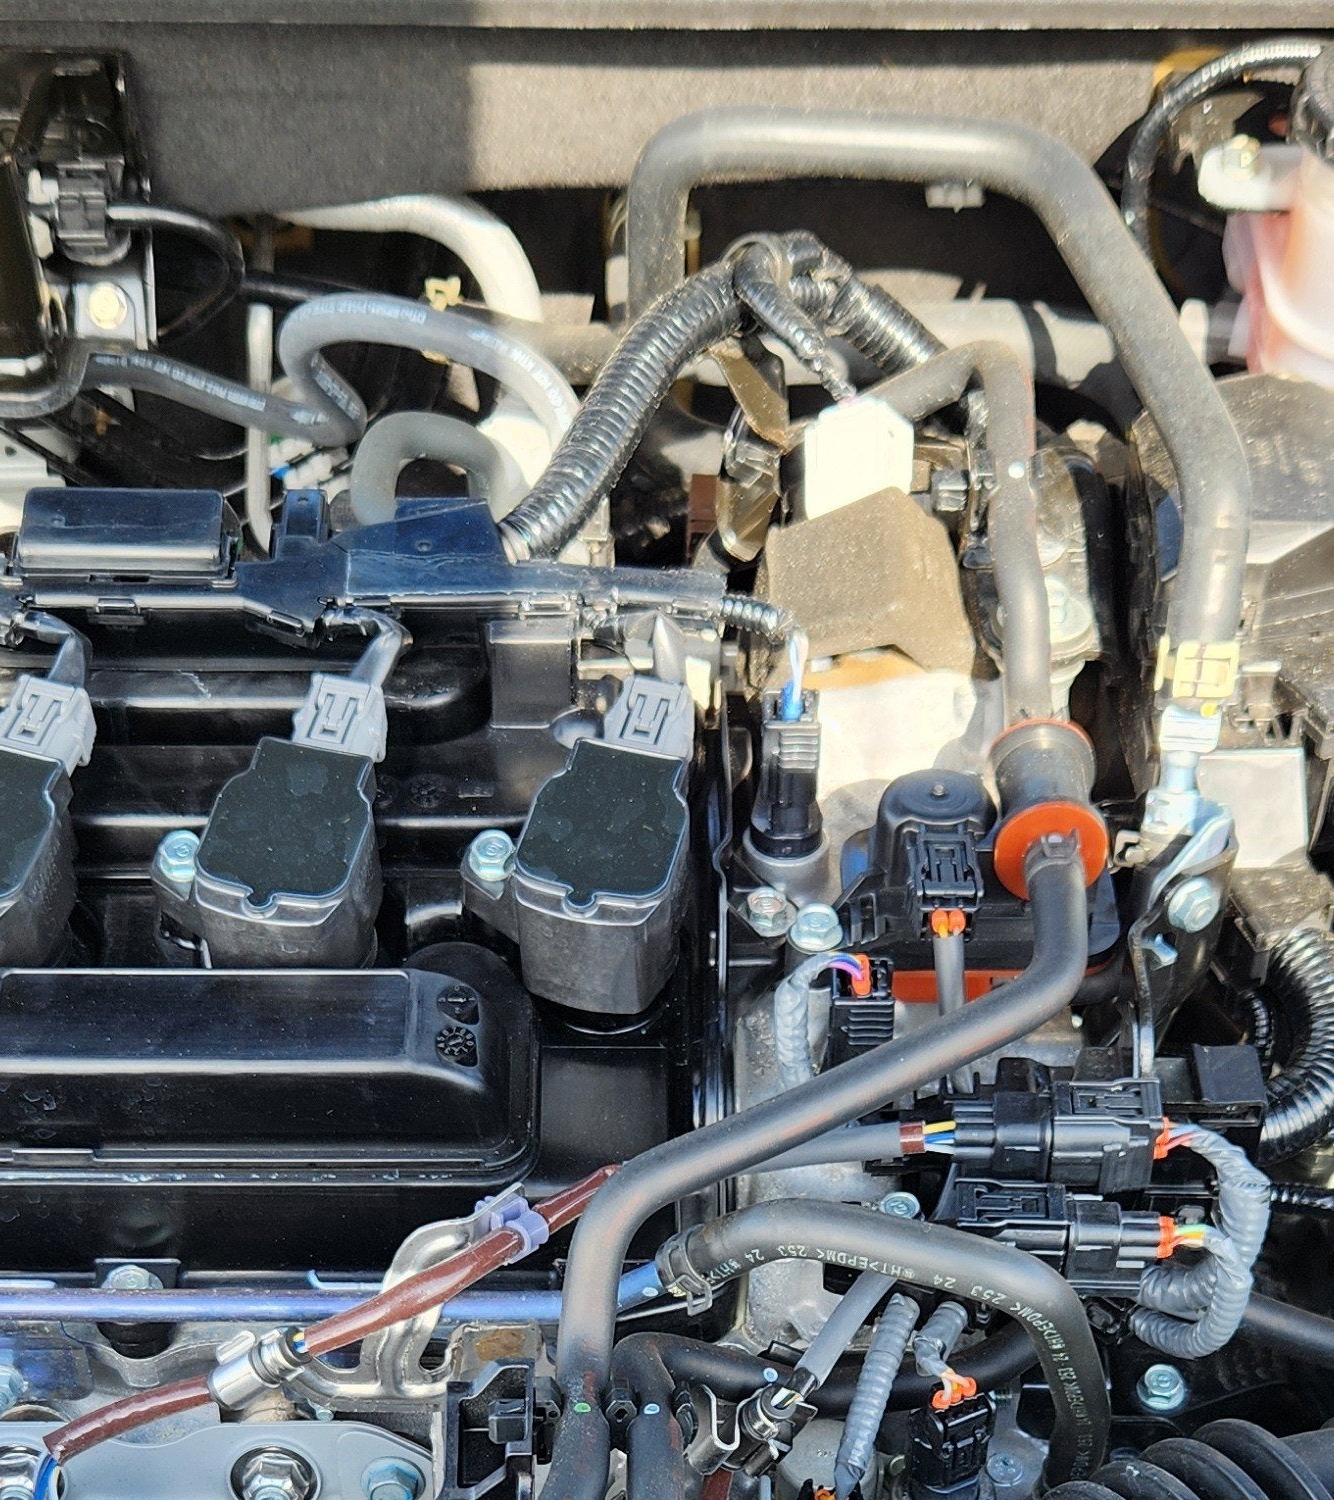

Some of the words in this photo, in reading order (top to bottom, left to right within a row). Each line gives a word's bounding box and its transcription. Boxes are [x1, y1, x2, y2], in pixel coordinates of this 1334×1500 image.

[745, 1248, 765, 1264] 24
[777, 1245, 808, 1258] 253
[933, 1274, 957, 1290] 24
[971, 1285, 1007, 1305] 253
